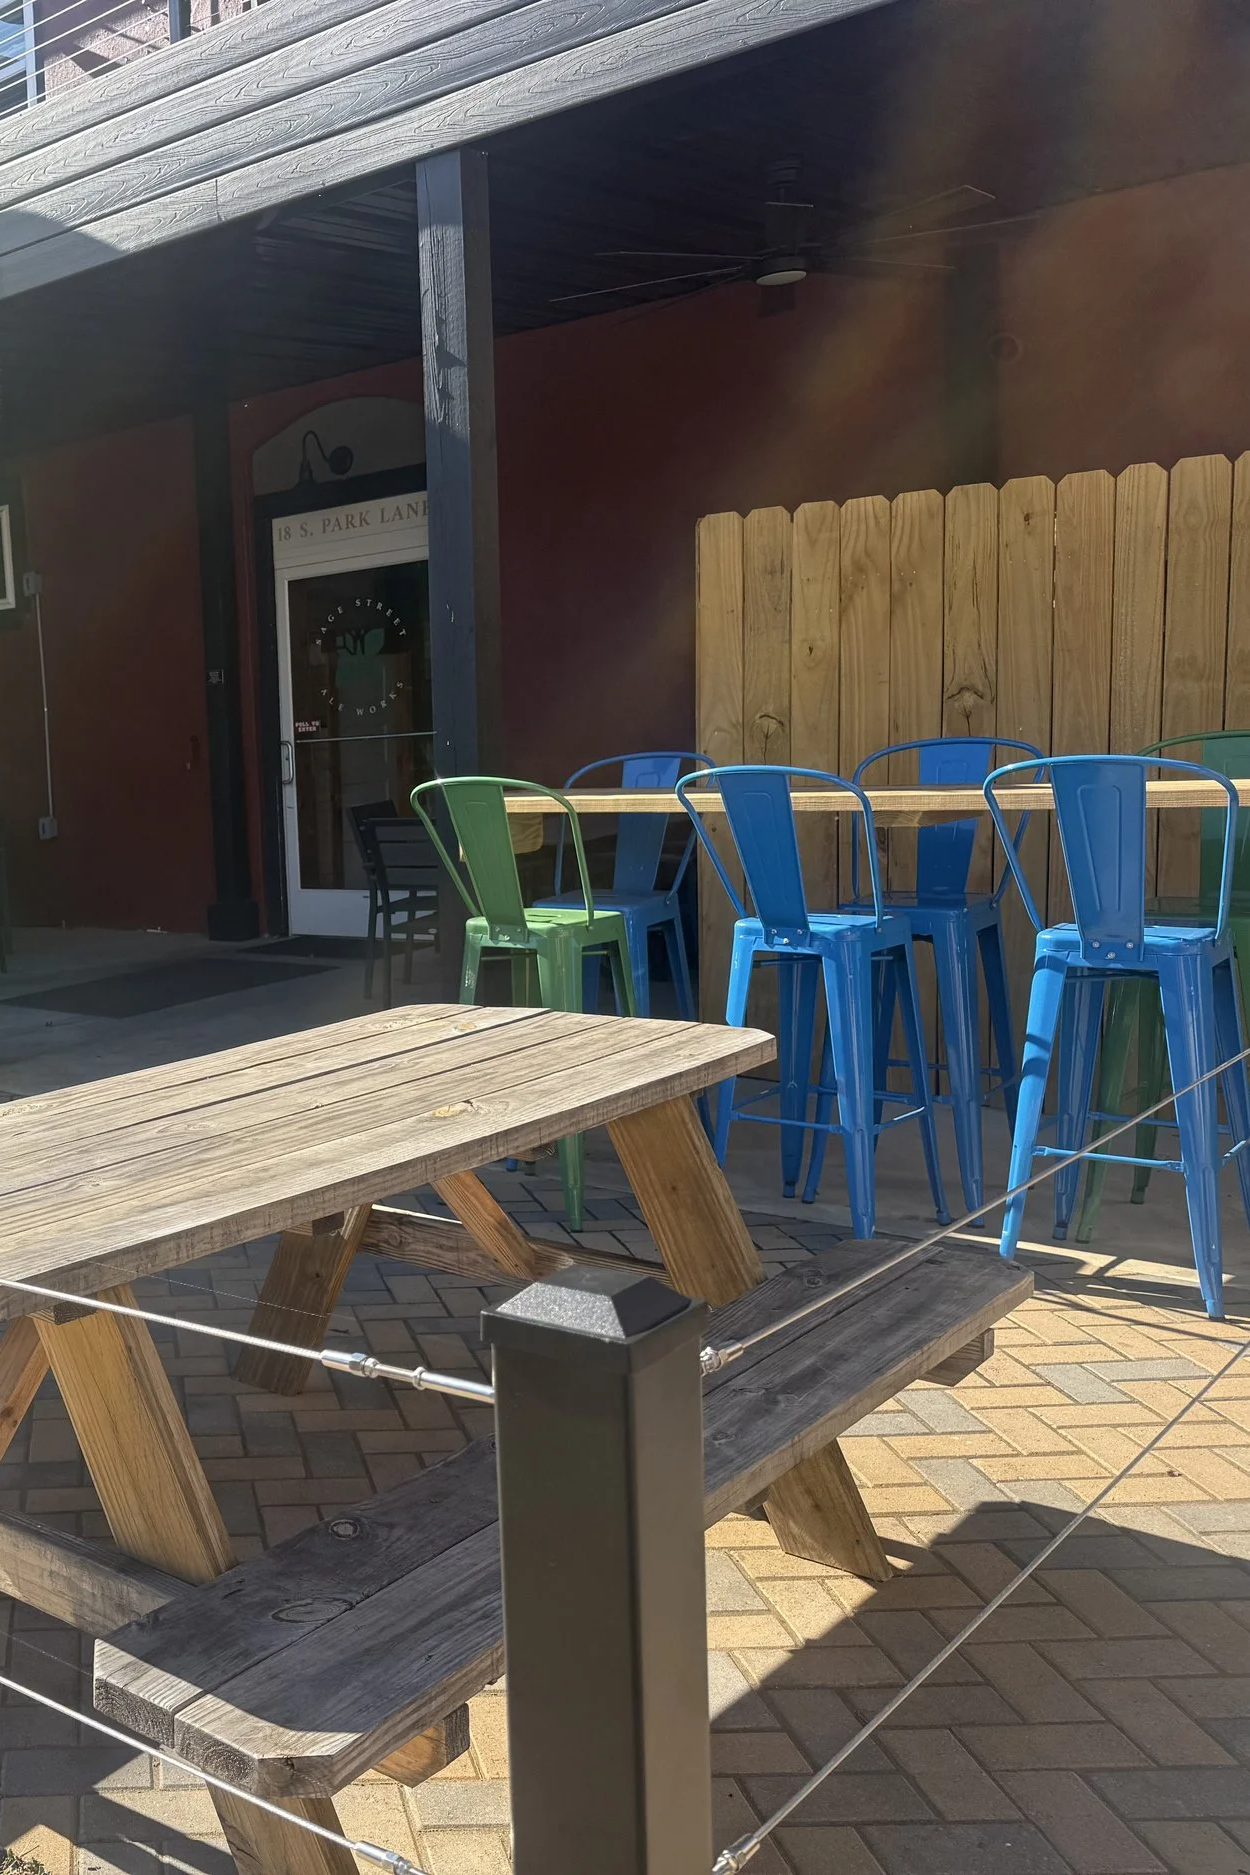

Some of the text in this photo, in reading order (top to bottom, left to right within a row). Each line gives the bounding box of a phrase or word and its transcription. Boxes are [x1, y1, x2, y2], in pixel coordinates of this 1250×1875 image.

[277, 526, 292, 542] 18
[300, 521, 314, 538] S.
[322, 510, 371, 534] PARK
[315, 599, 407, 646] SAGE STREET
[320, 681, 404, 716] ALE WORKS
